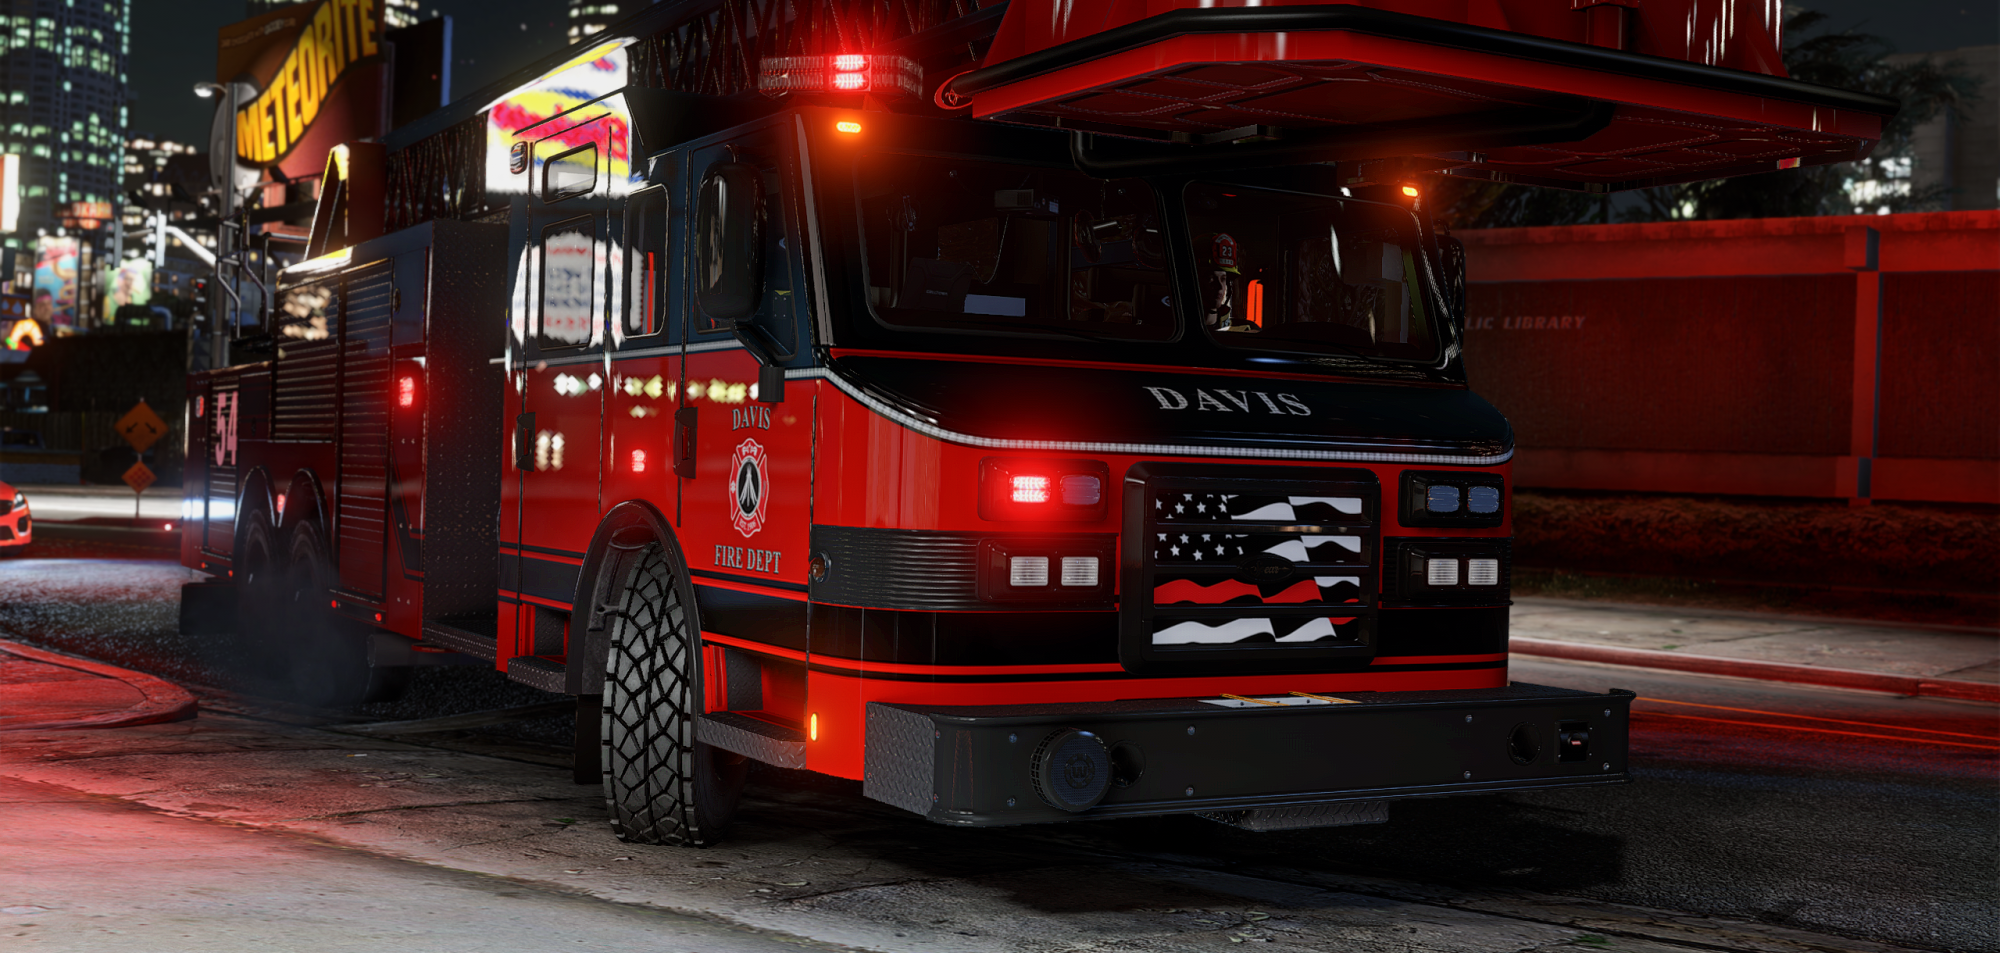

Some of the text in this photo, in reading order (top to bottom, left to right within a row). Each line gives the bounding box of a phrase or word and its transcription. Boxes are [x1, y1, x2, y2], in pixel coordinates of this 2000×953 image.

[236, 0, 378, 162] METEORITE
[1222, 245, 1233, 258] 23
[1503, 316, 1586, 330] LIBRARY
[1142, 386, 1312, 416] DAVIS
[215, 390, 239, 467] 54
[732, 405, 771, 431] DAVIS
[714, 544, 781, 574] FIRE DEPT
